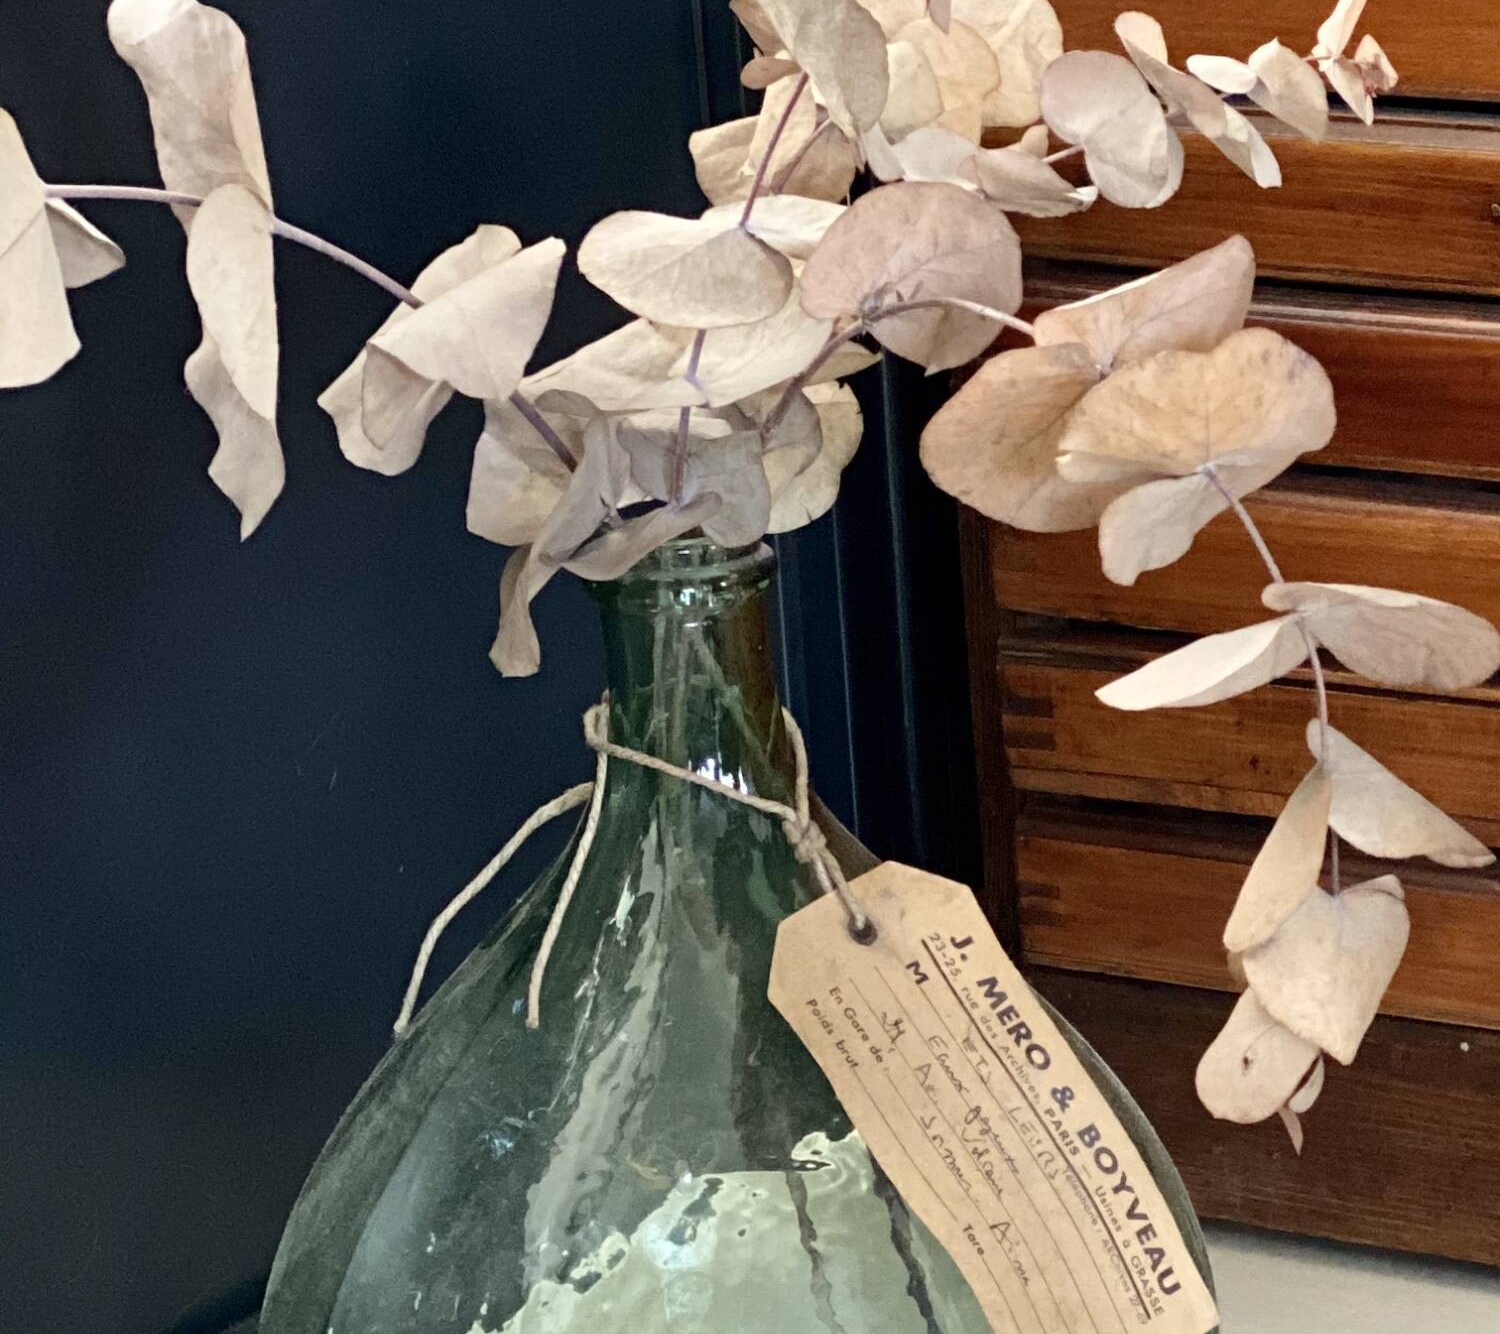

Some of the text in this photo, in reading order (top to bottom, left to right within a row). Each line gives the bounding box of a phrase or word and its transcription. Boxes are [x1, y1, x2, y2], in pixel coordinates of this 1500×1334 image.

[904, 959, 930, 986] M
[804, 997, 860, 1069] Poids brut
[827, 984, 844, 1005] En
[842, 1006, 870, 1042] Gare
[867, 1044, 884, 1064] de
[948, 934, 1182, 1296] J. MERO & BOYVEAU
[959, 985, 979, 1010] rue
[978, 1014, 999, 1040] des
[1042, 1106, 1080, 1156] PARIS
[1093, 1184, 1123, 1233] Usines
[1122, 1254, 1165, 1317] GRASSE
[961, 1222, 985, 1256] Tare
